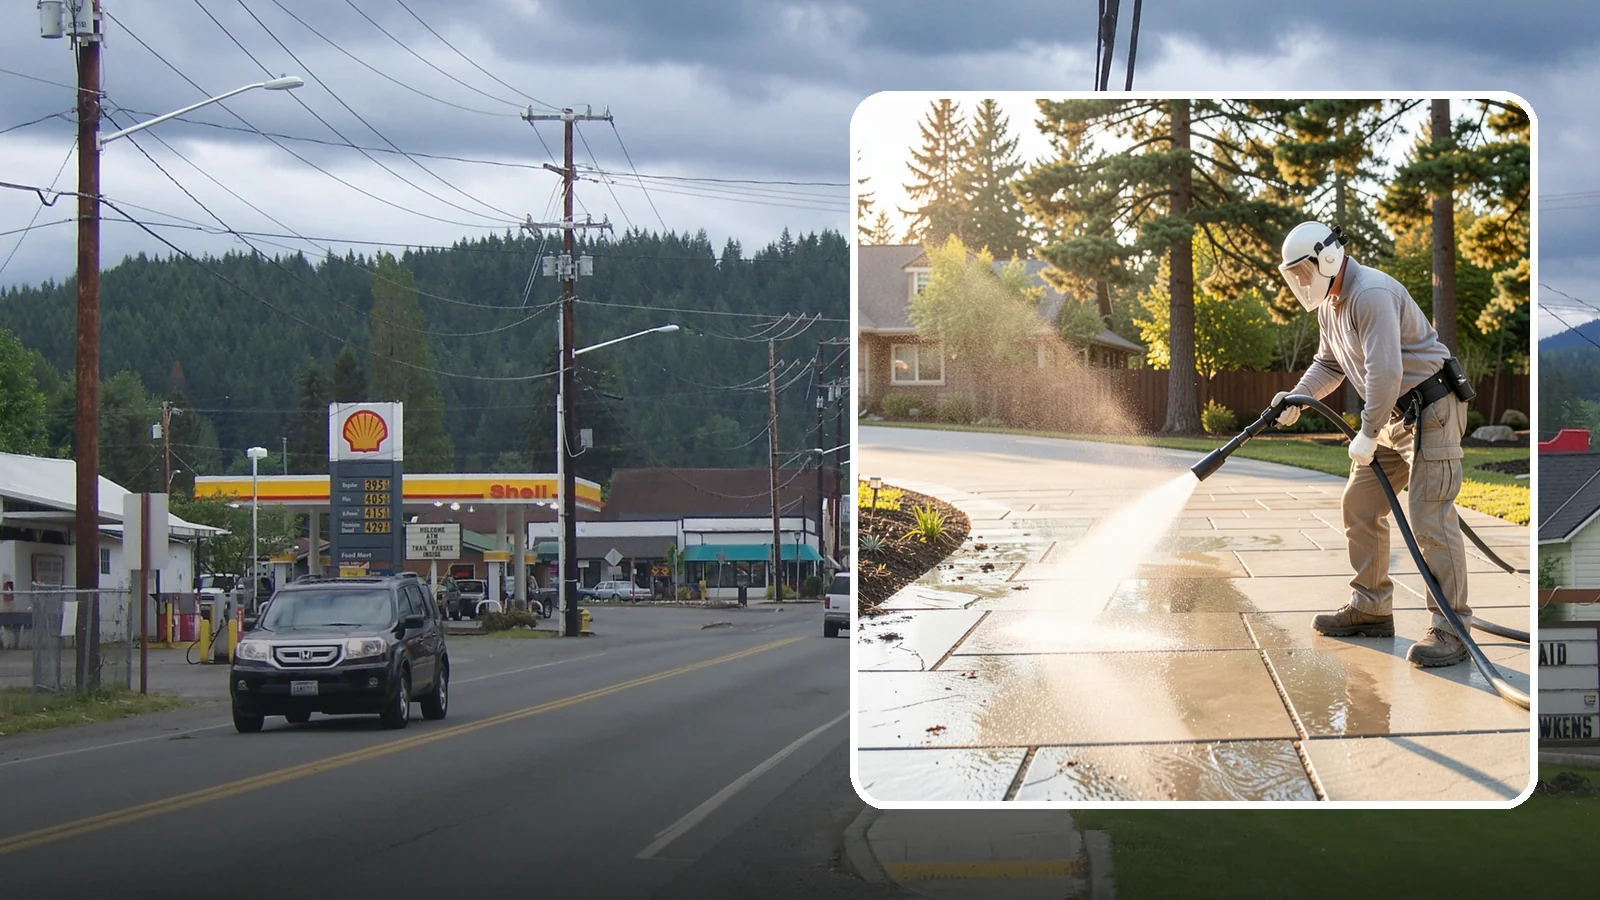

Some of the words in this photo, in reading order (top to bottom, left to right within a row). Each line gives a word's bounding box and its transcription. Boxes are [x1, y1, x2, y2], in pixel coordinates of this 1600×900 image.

[365, 480, 384, 490] 395
[490, 484, 547, 499] Shell
[365, 494, 384, 504] 405
[365, 508, 383, 518] 415
[365, 522, 384, 533] 429
